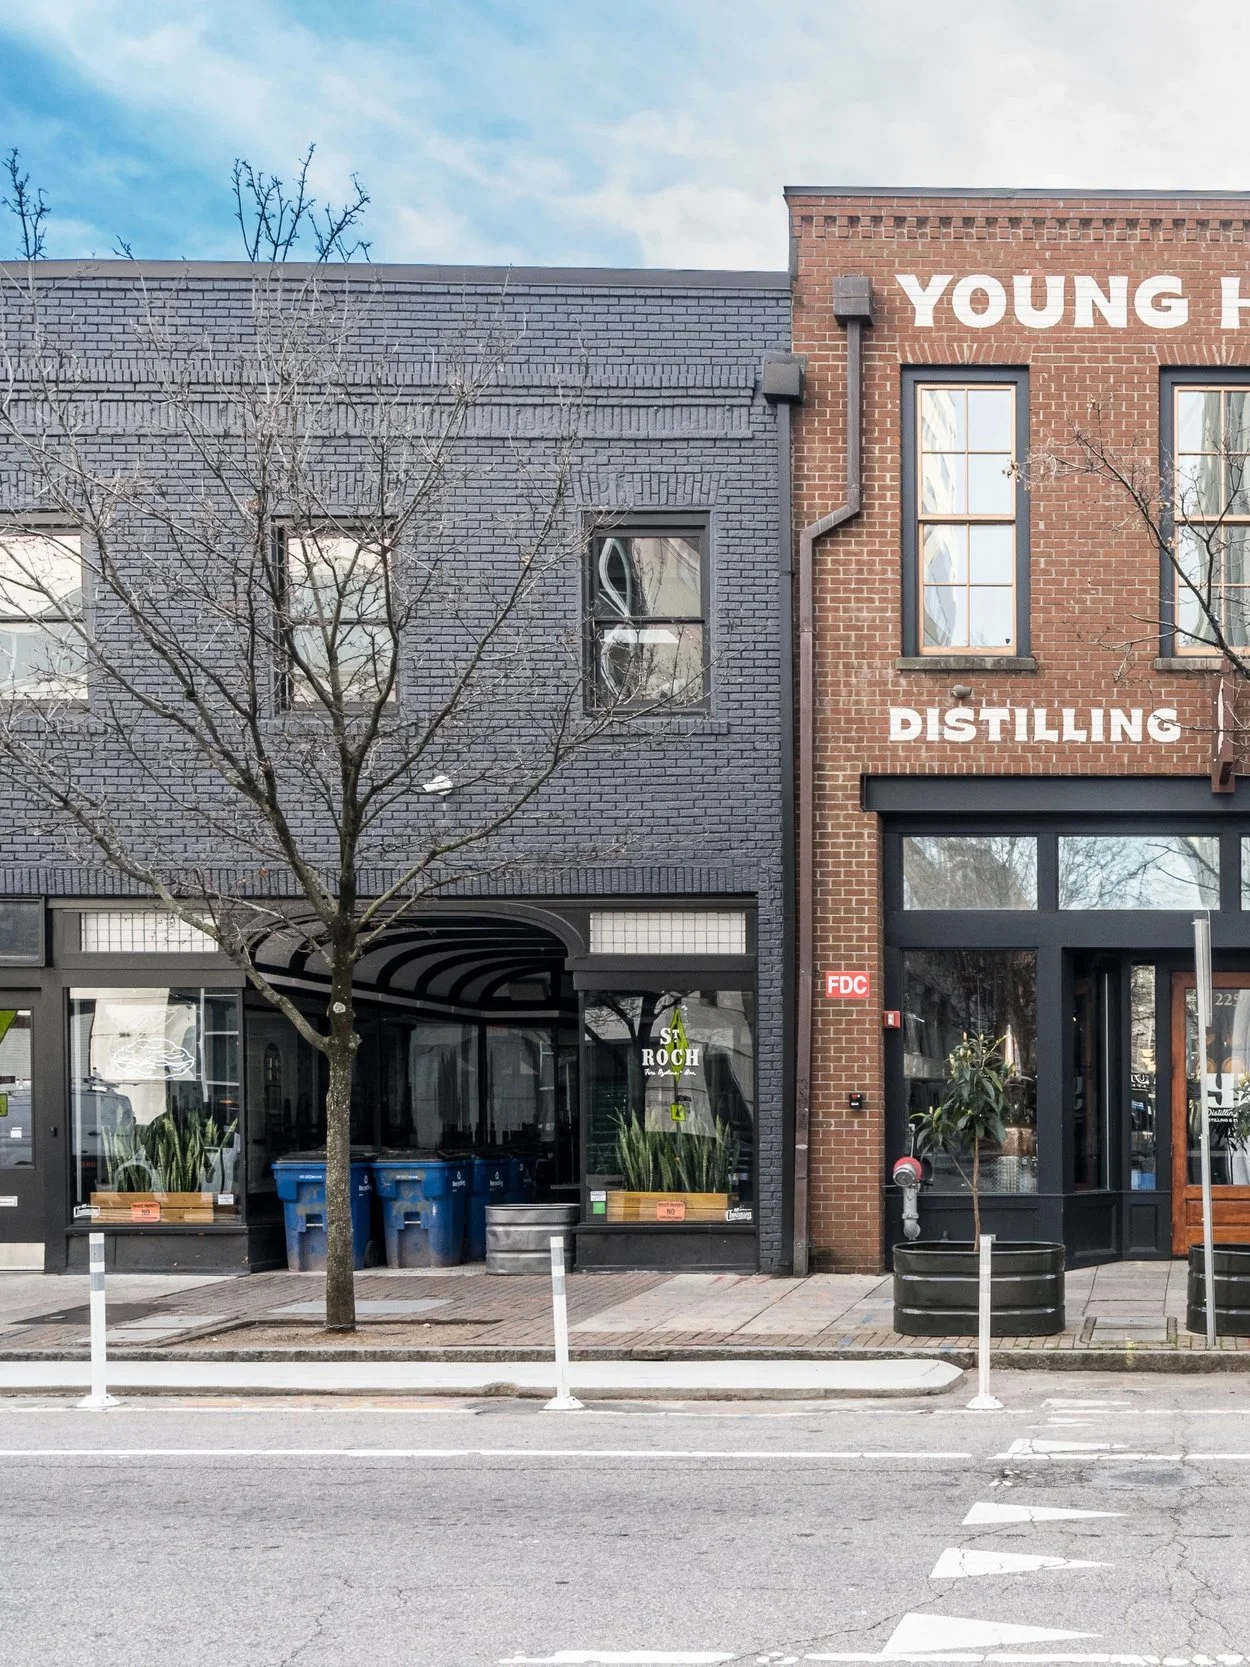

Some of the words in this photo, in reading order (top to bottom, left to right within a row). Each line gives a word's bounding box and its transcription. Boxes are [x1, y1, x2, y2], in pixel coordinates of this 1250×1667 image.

[894, 274, 1190, 330] YOUNG
[887, 707, 1182, 744] DISTILLING
[827, 975, 867, 994] FDC
[1215, 993, 1240, 1006] 225
[641, 1049, 700, 1066] ROCH
[667, 1208, 676, 1216] NO
